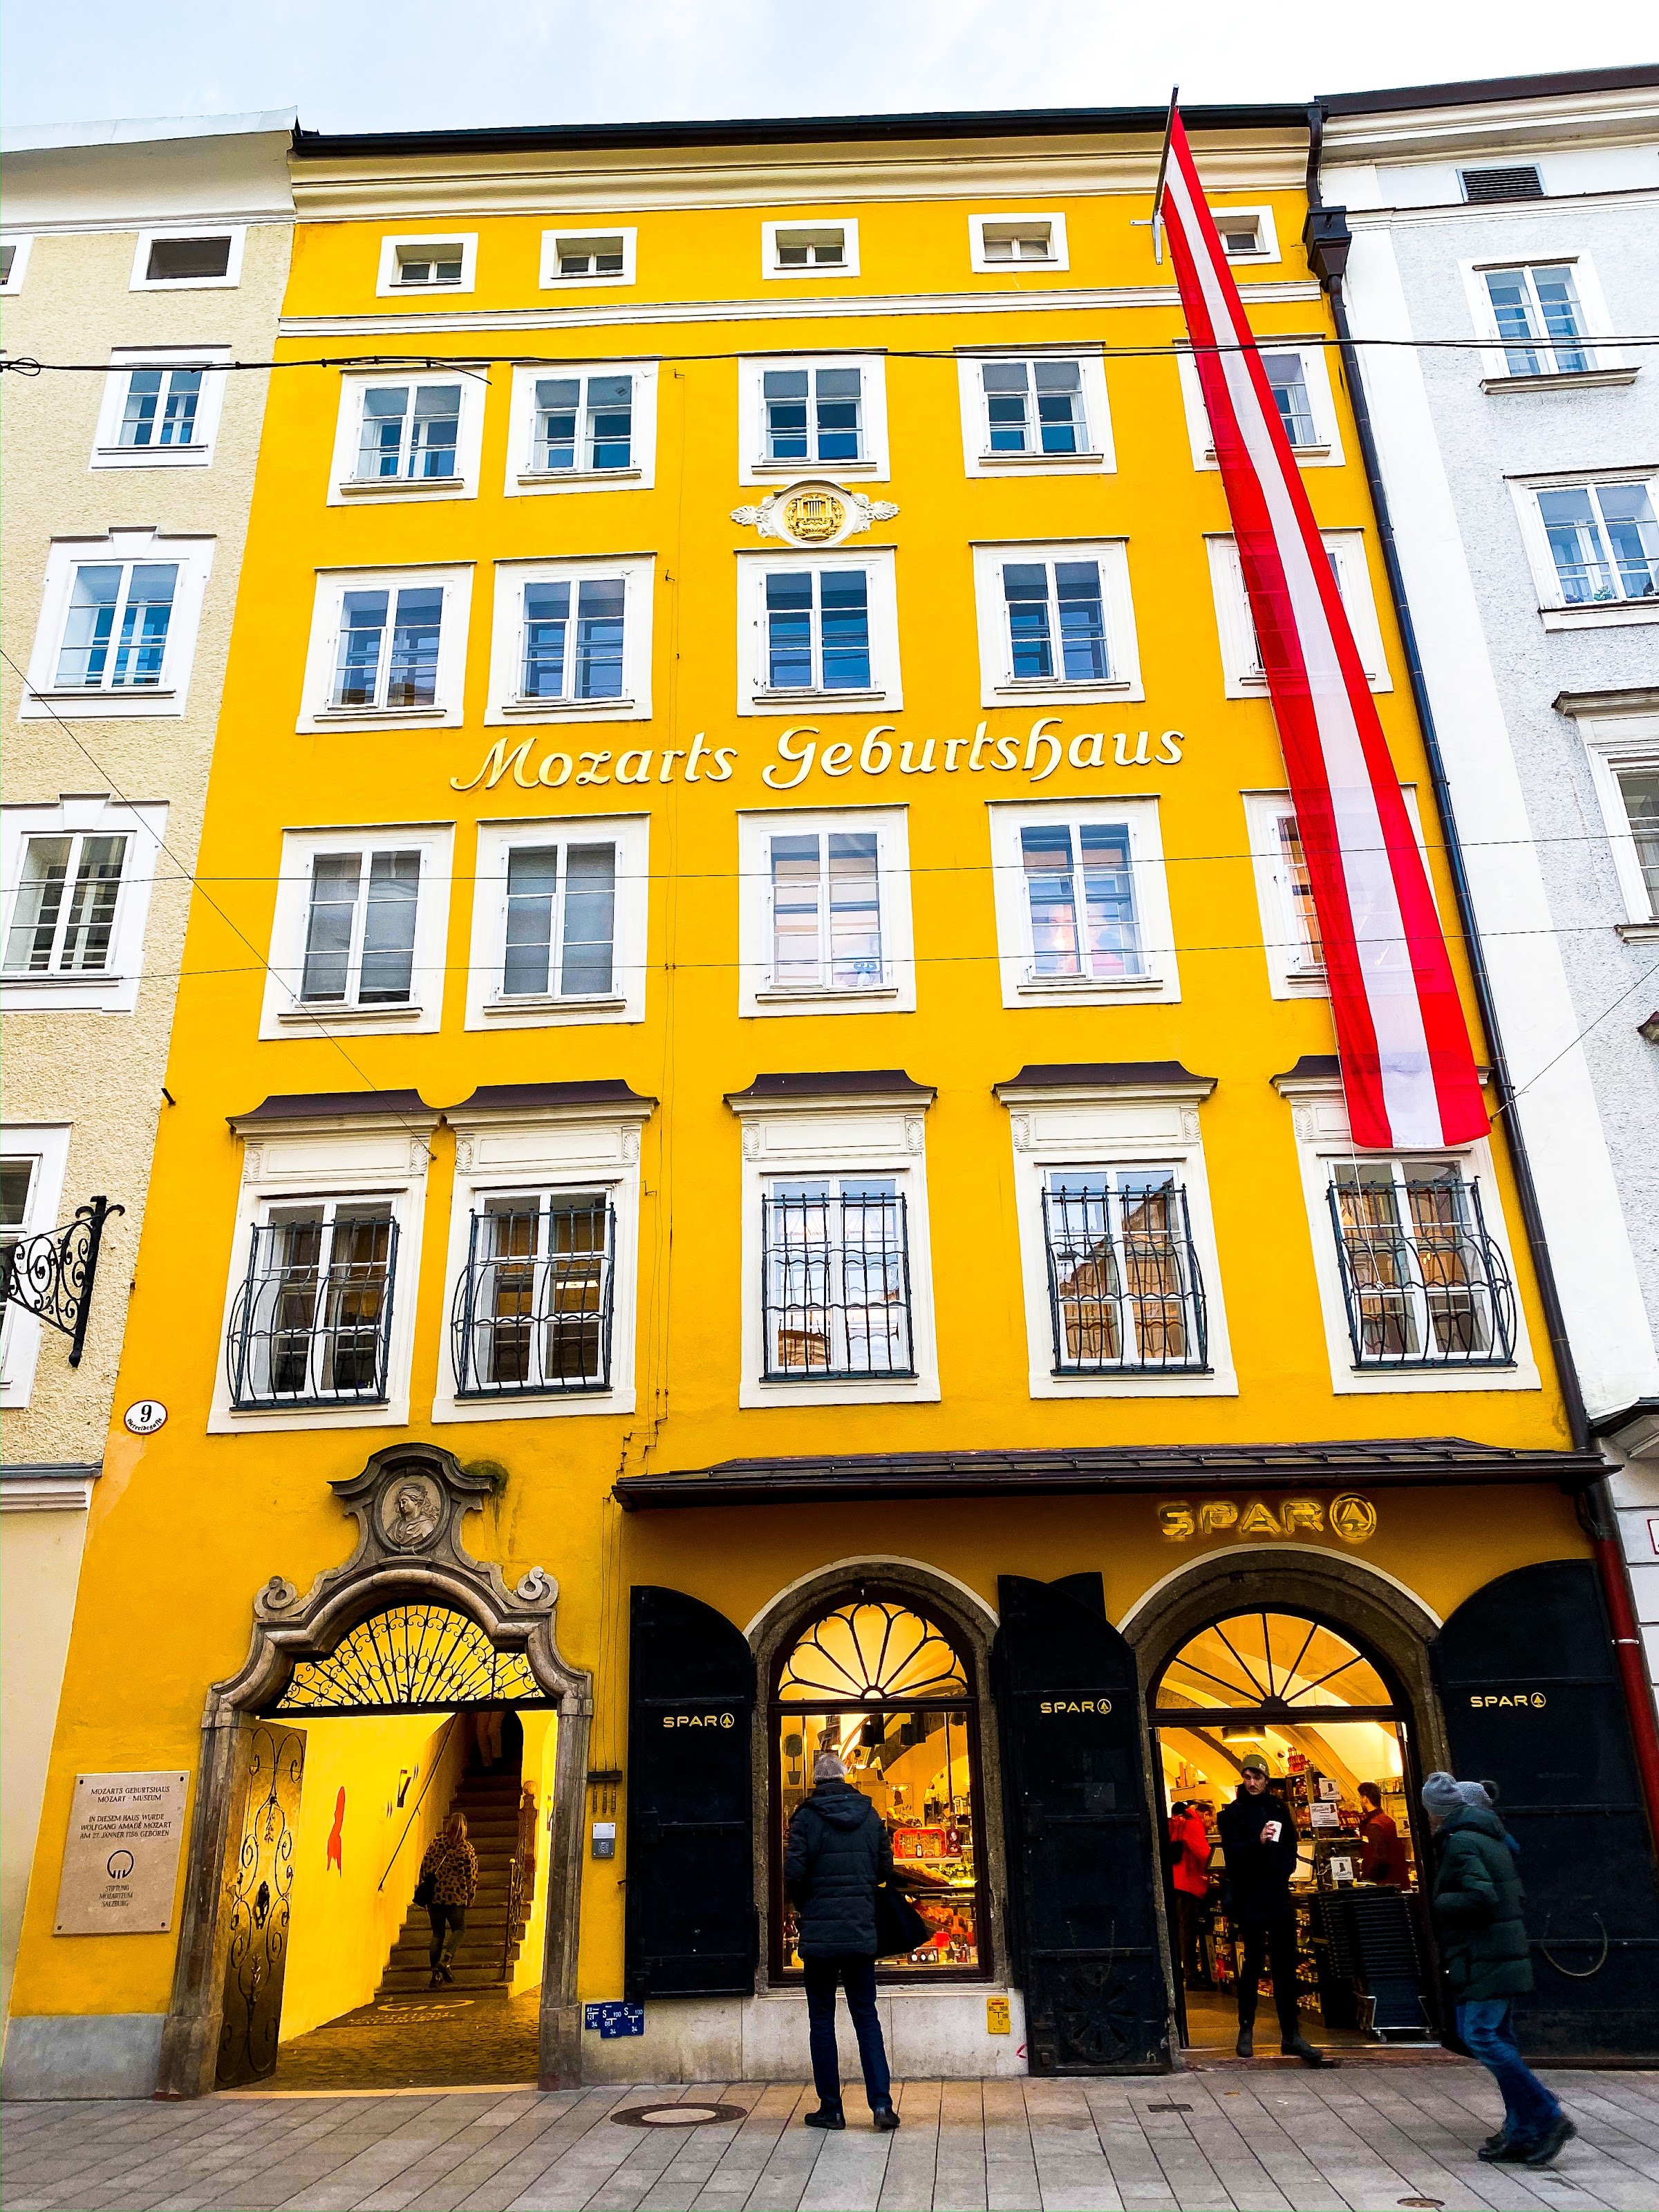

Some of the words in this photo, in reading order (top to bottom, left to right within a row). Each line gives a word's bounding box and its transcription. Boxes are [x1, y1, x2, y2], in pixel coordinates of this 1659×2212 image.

[450, 731, 738, 791] Mozarts
[762, 717, 1185, 789] Geburtshaus
[140, 1405, 152, 1423] 9
[1159, 1501, 1324, 1536] SPAR
[1470, 1695, 1528, 1707] SPAR
[1040, 1701, 1094, 1714] SPAR
[663, 1715, 718, 1728] SPAR
[91, 1787, 123, 1795] MOZARTS
[125, 1785, 171, 1794] GEBURTSHAUS
[132, 1794, 162, 1802] MUSEUM
[140, 1830, 169, 1838] GEBOREN
[602, 2009, 606, 2018] S
[624, 2007, 628, 2015] S
